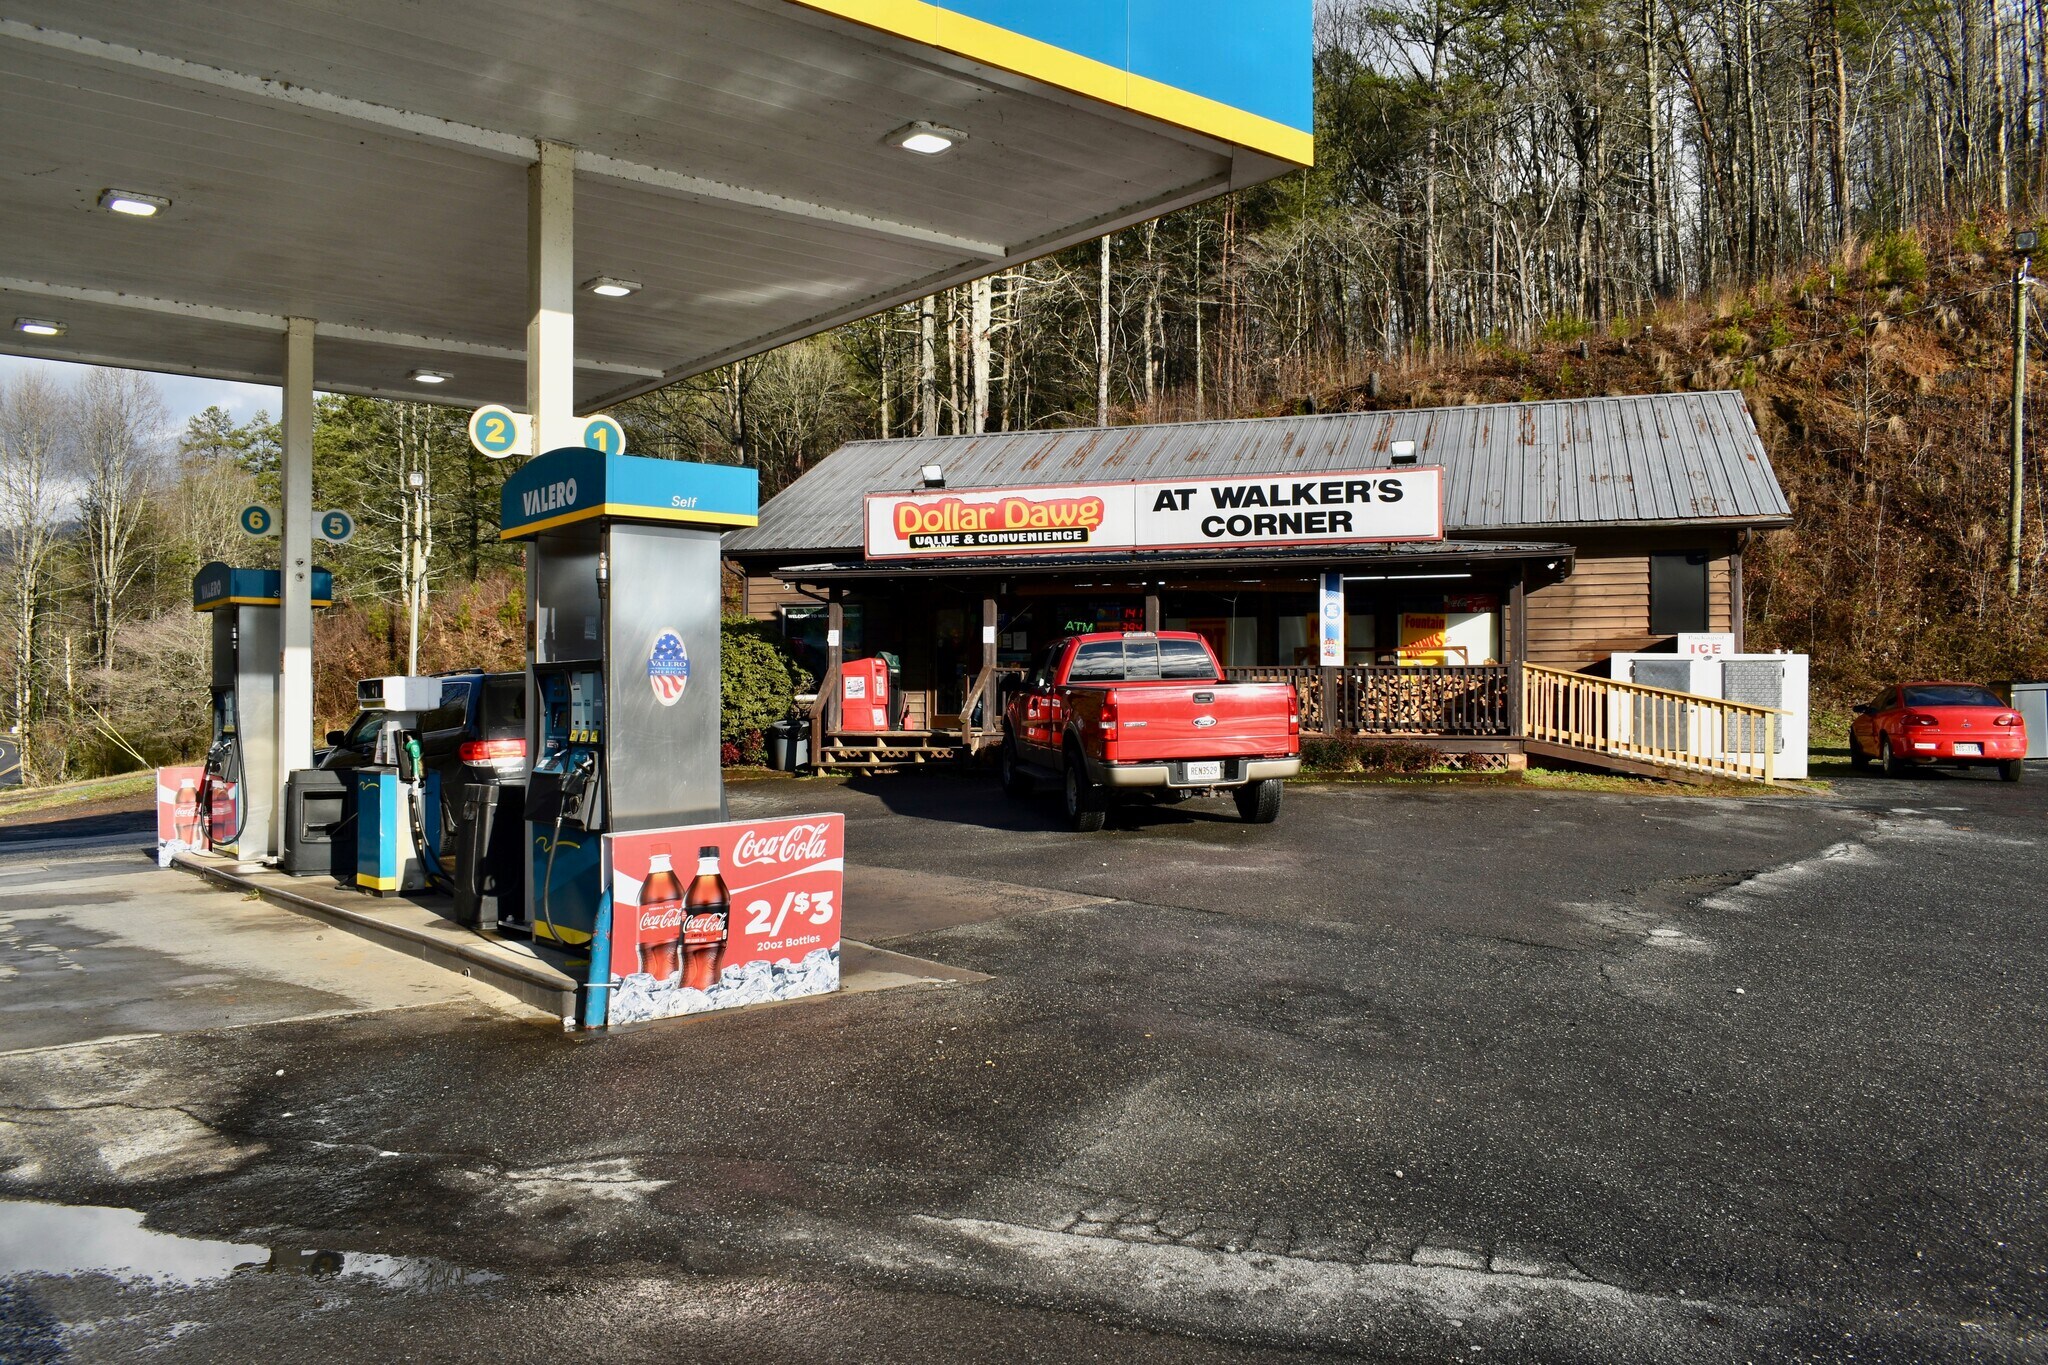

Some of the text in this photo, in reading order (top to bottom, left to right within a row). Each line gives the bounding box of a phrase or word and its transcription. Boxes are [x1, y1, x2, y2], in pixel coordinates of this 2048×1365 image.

[485, 418, 506, 444] 2
[593, 428, 607, 450] 1
[523, 478, 578, 517] VALERO
[671, 495, 698, 509] Self
[1153, 478, 1403, 512] AT WALKER'S
[249, 510, 263, 529] 6
[898, 494, 1102, 535] Dollar Dawg
[1200, 509, 1353, 539] CORNER
[329, 517, 343, 535] 5
[915, 529, 1083, 547] VALUE & CONVENIENCE
[201, 579, 222, 601] VALERO
[1064, 620, 1094, 633] ATM
[1404, 613, 1445, 630] Fountain
[1403, 632, 1444, 660] DRINKS
[1690, 643, 1722, 655] ICE
[650, 660, 687, 668] VALERO
[732, 822, 831, 868] Coca-Cola
[682, 912, 728, 934] Coca-Cola
[744, 890, 834, 938] 2/$3
[756, 934, 821, 952] 20oz Bottles
